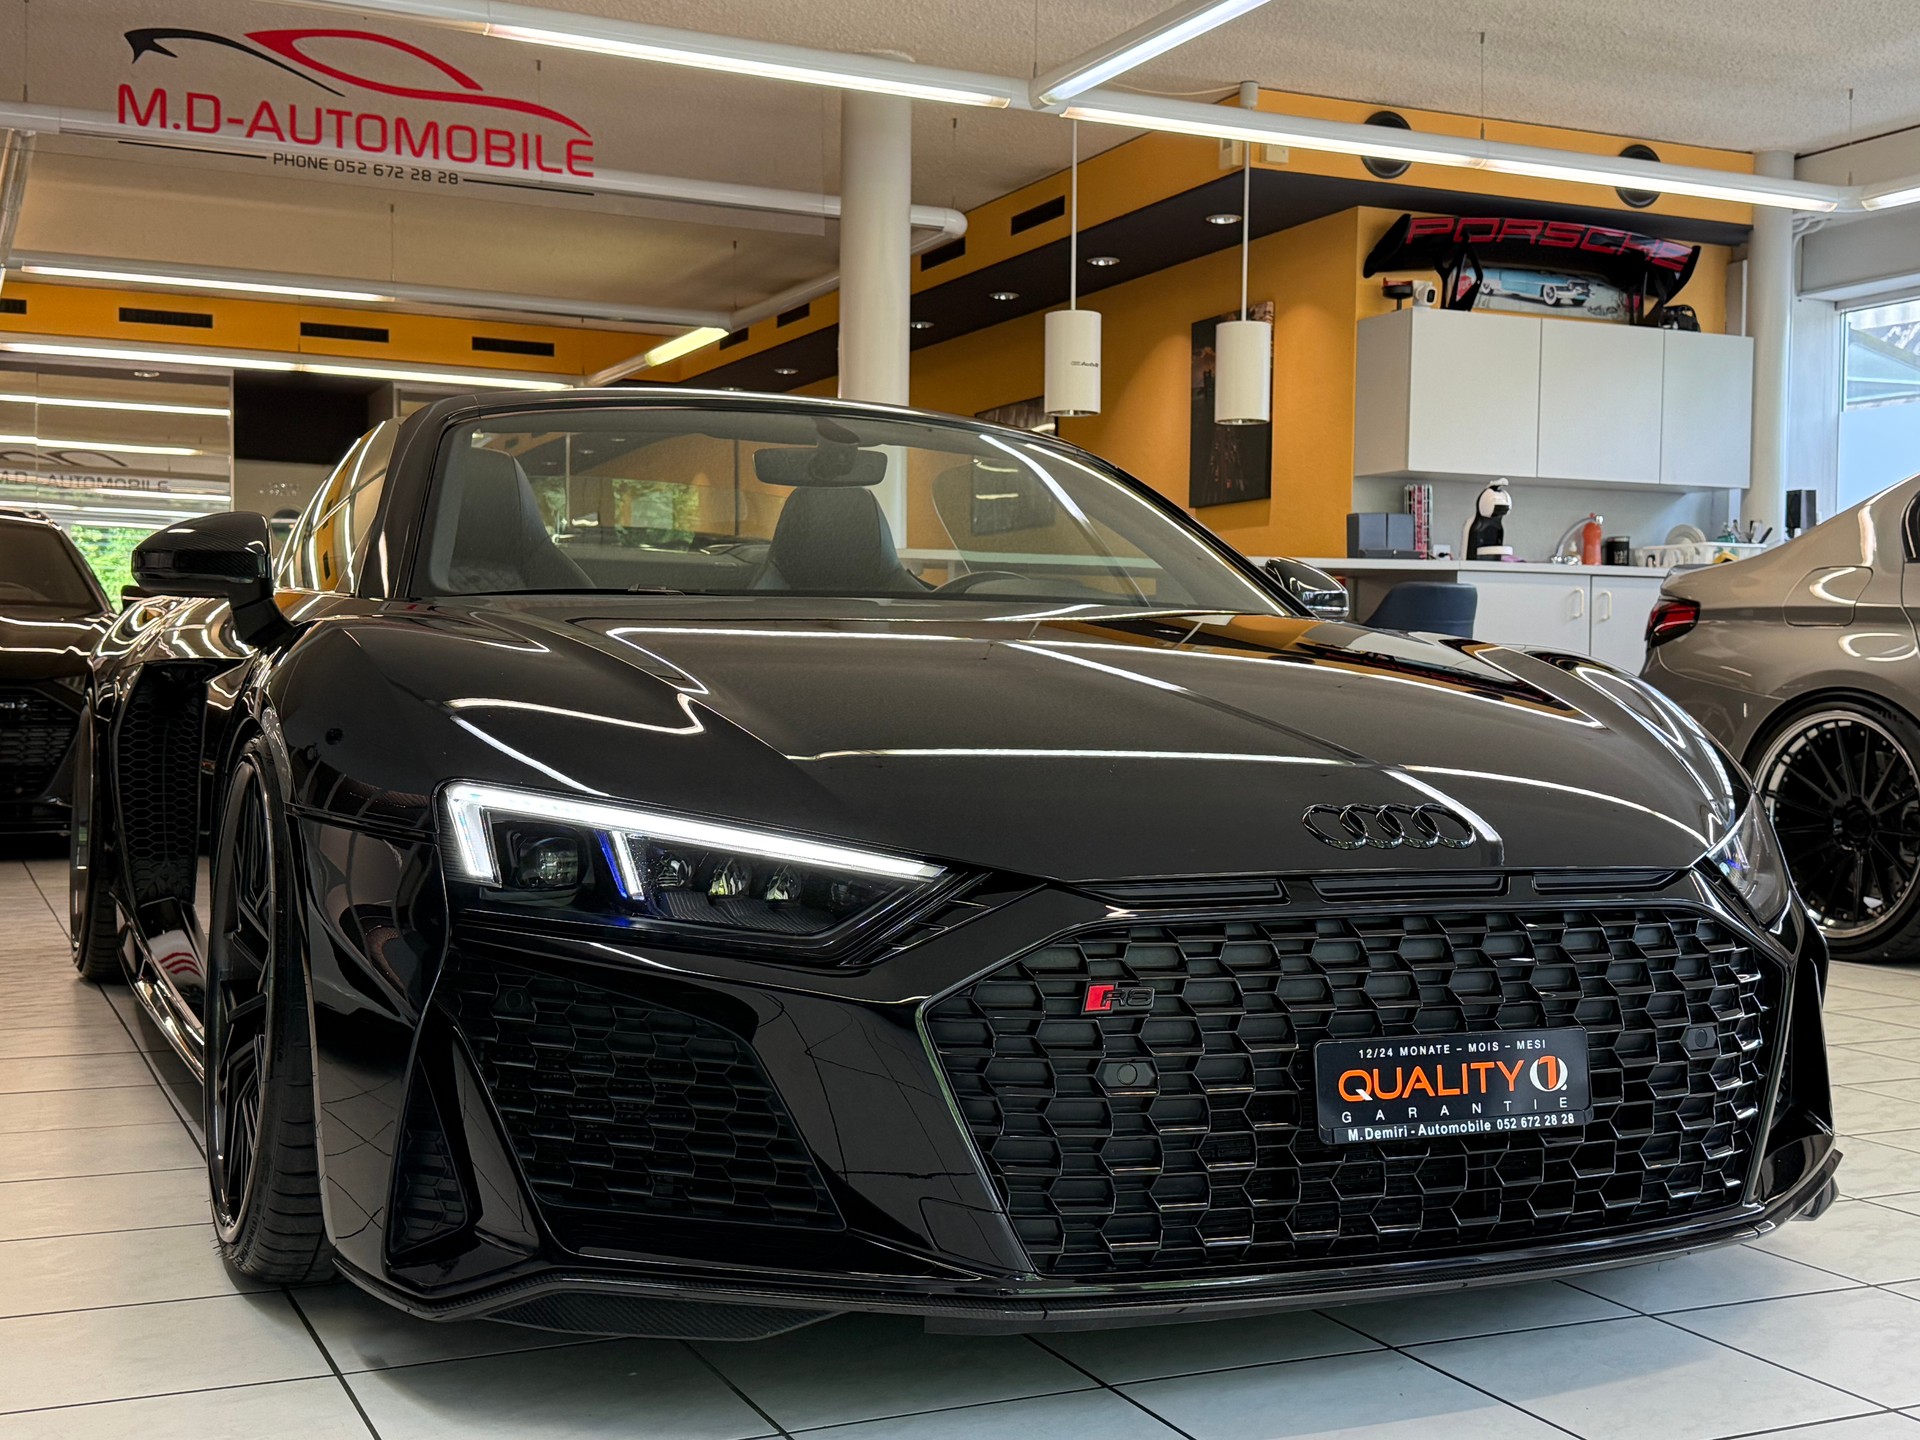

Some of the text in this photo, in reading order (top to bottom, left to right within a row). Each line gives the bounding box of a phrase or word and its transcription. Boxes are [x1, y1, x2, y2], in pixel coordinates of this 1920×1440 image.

[117, 84, 594, 178] M.D-AUTOMOBILE
[273, 152, 459, 185] PHONE 052 672 28 28
[1405, 217, 1693, 271] PORSCHE
[1358, 1048, 1393, 1059] 12/24
[1400, 1044, 1450, 1056] MONATE
[1468, 1041, 1499, 1052] MOIS
[1516, 1039, 1546, 1050] MESI
[1338, 1059, 1525, 1102] QUALITY
[1418, 1120, 1492, 1137] Automobile
[1496, 1117, 1517, 1130] 052
[1521, 1116, 1541, 1128] 672
[1544, 1114, 1558, 1126] 28
[1561, 1113, 1575, 1125] 28
